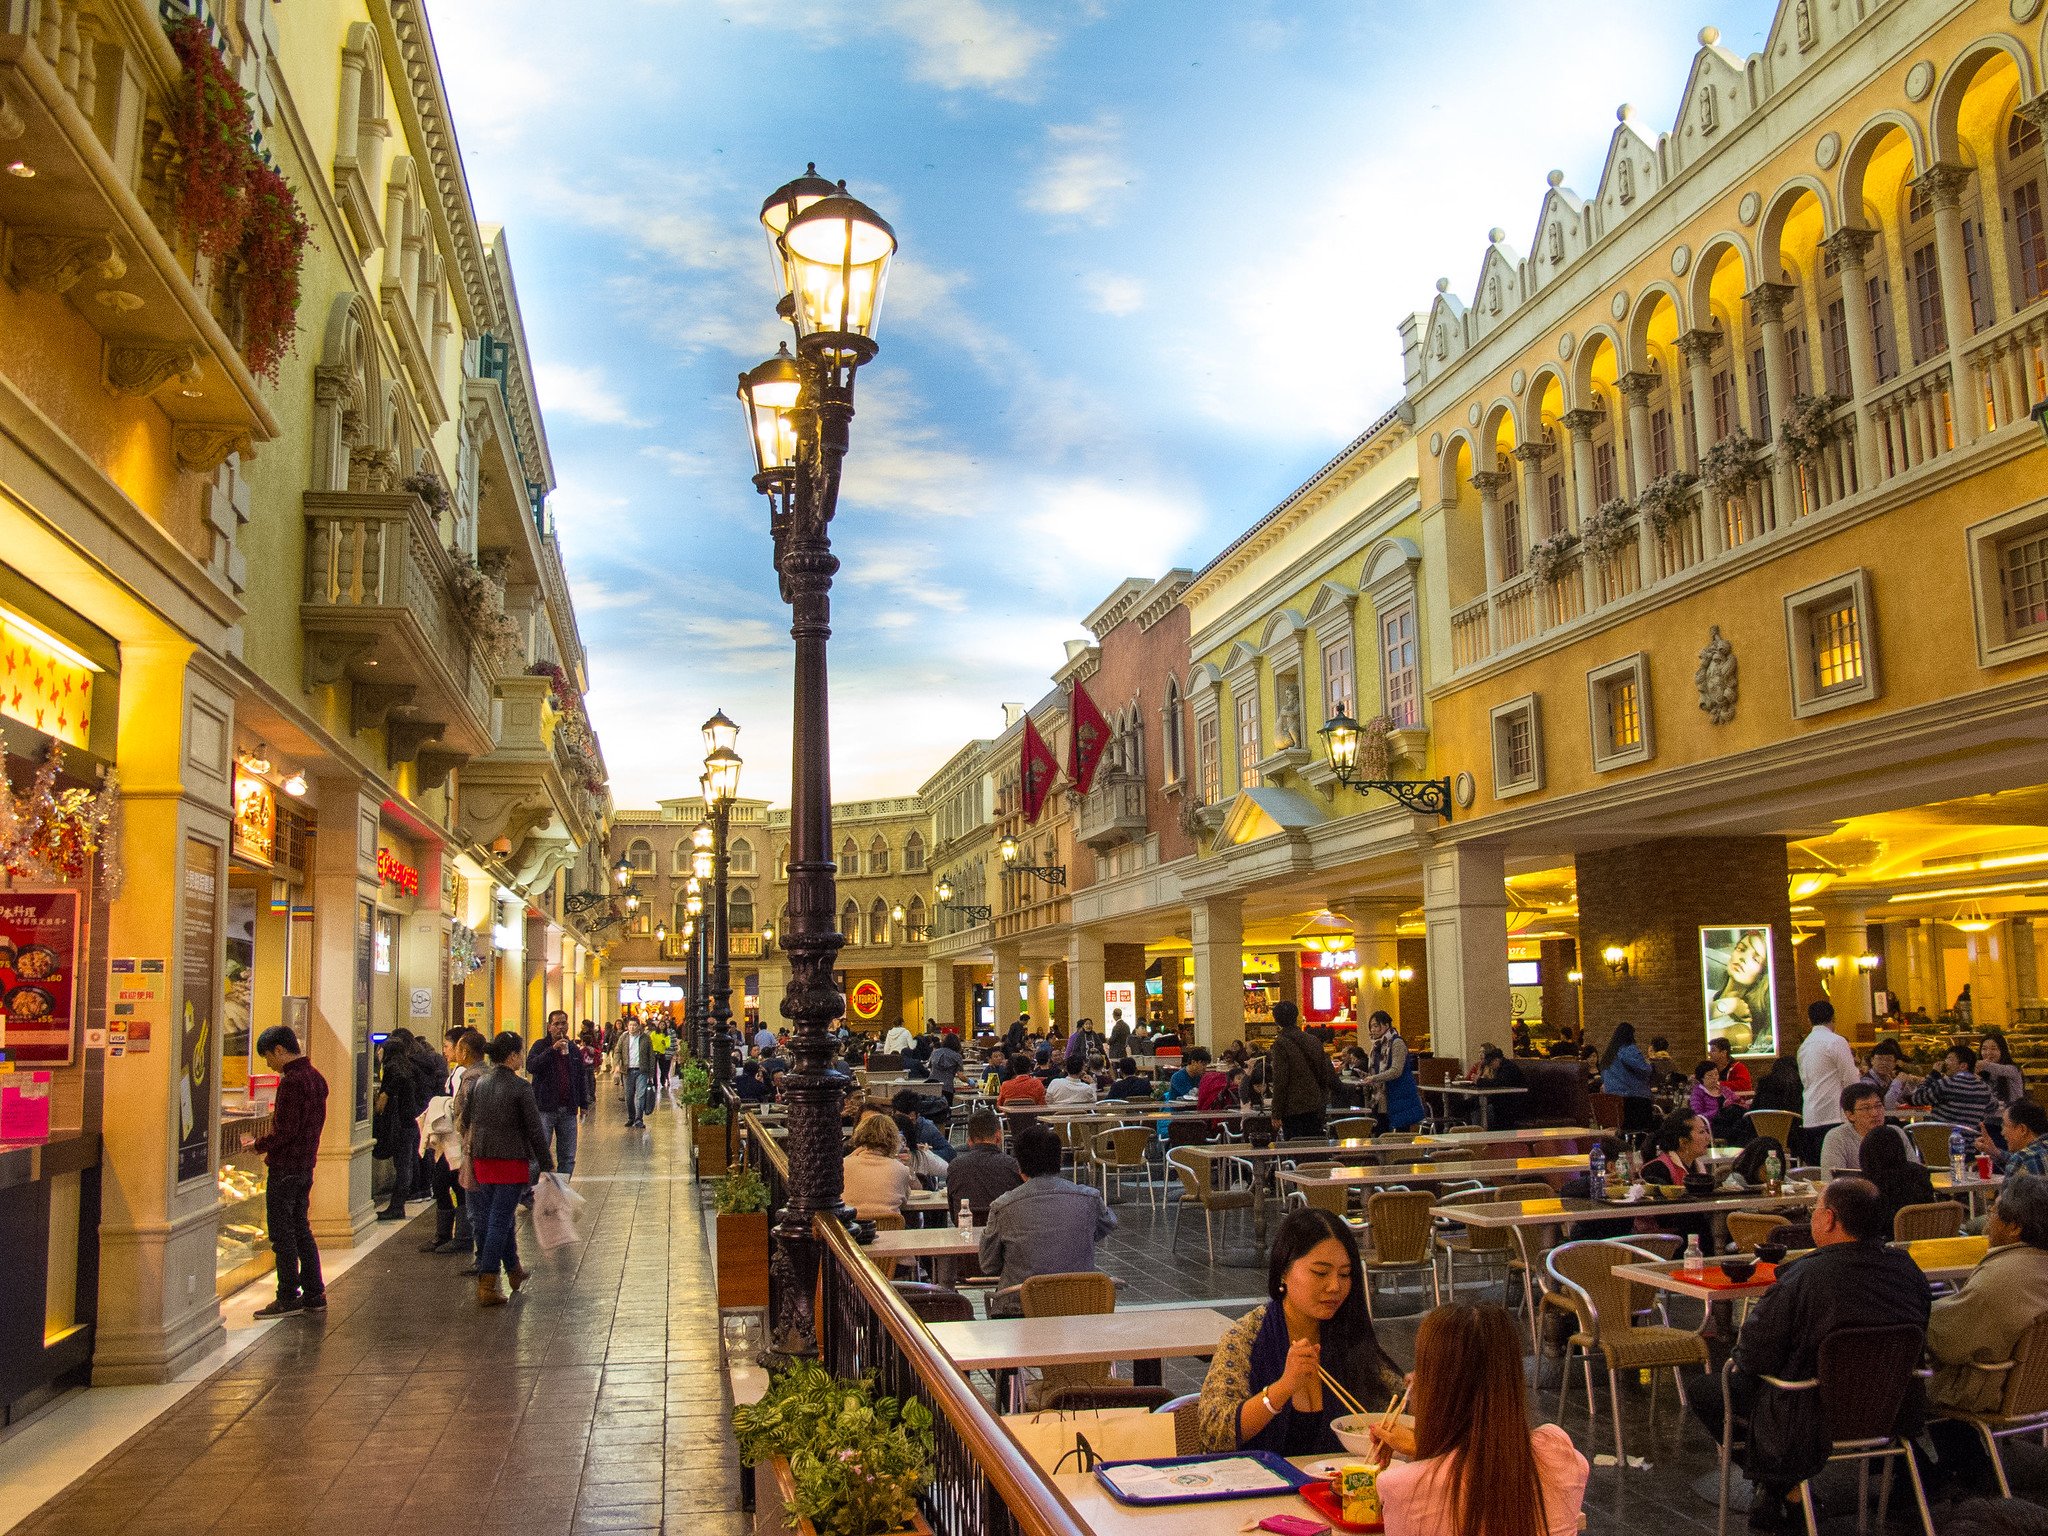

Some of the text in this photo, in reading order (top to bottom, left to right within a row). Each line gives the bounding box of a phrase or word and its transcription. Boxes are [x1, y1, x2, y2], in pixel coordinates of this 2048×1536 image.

[1508, 947, 1526, 955] ore
[119, 991, 155, 1000] 歡迎使用
